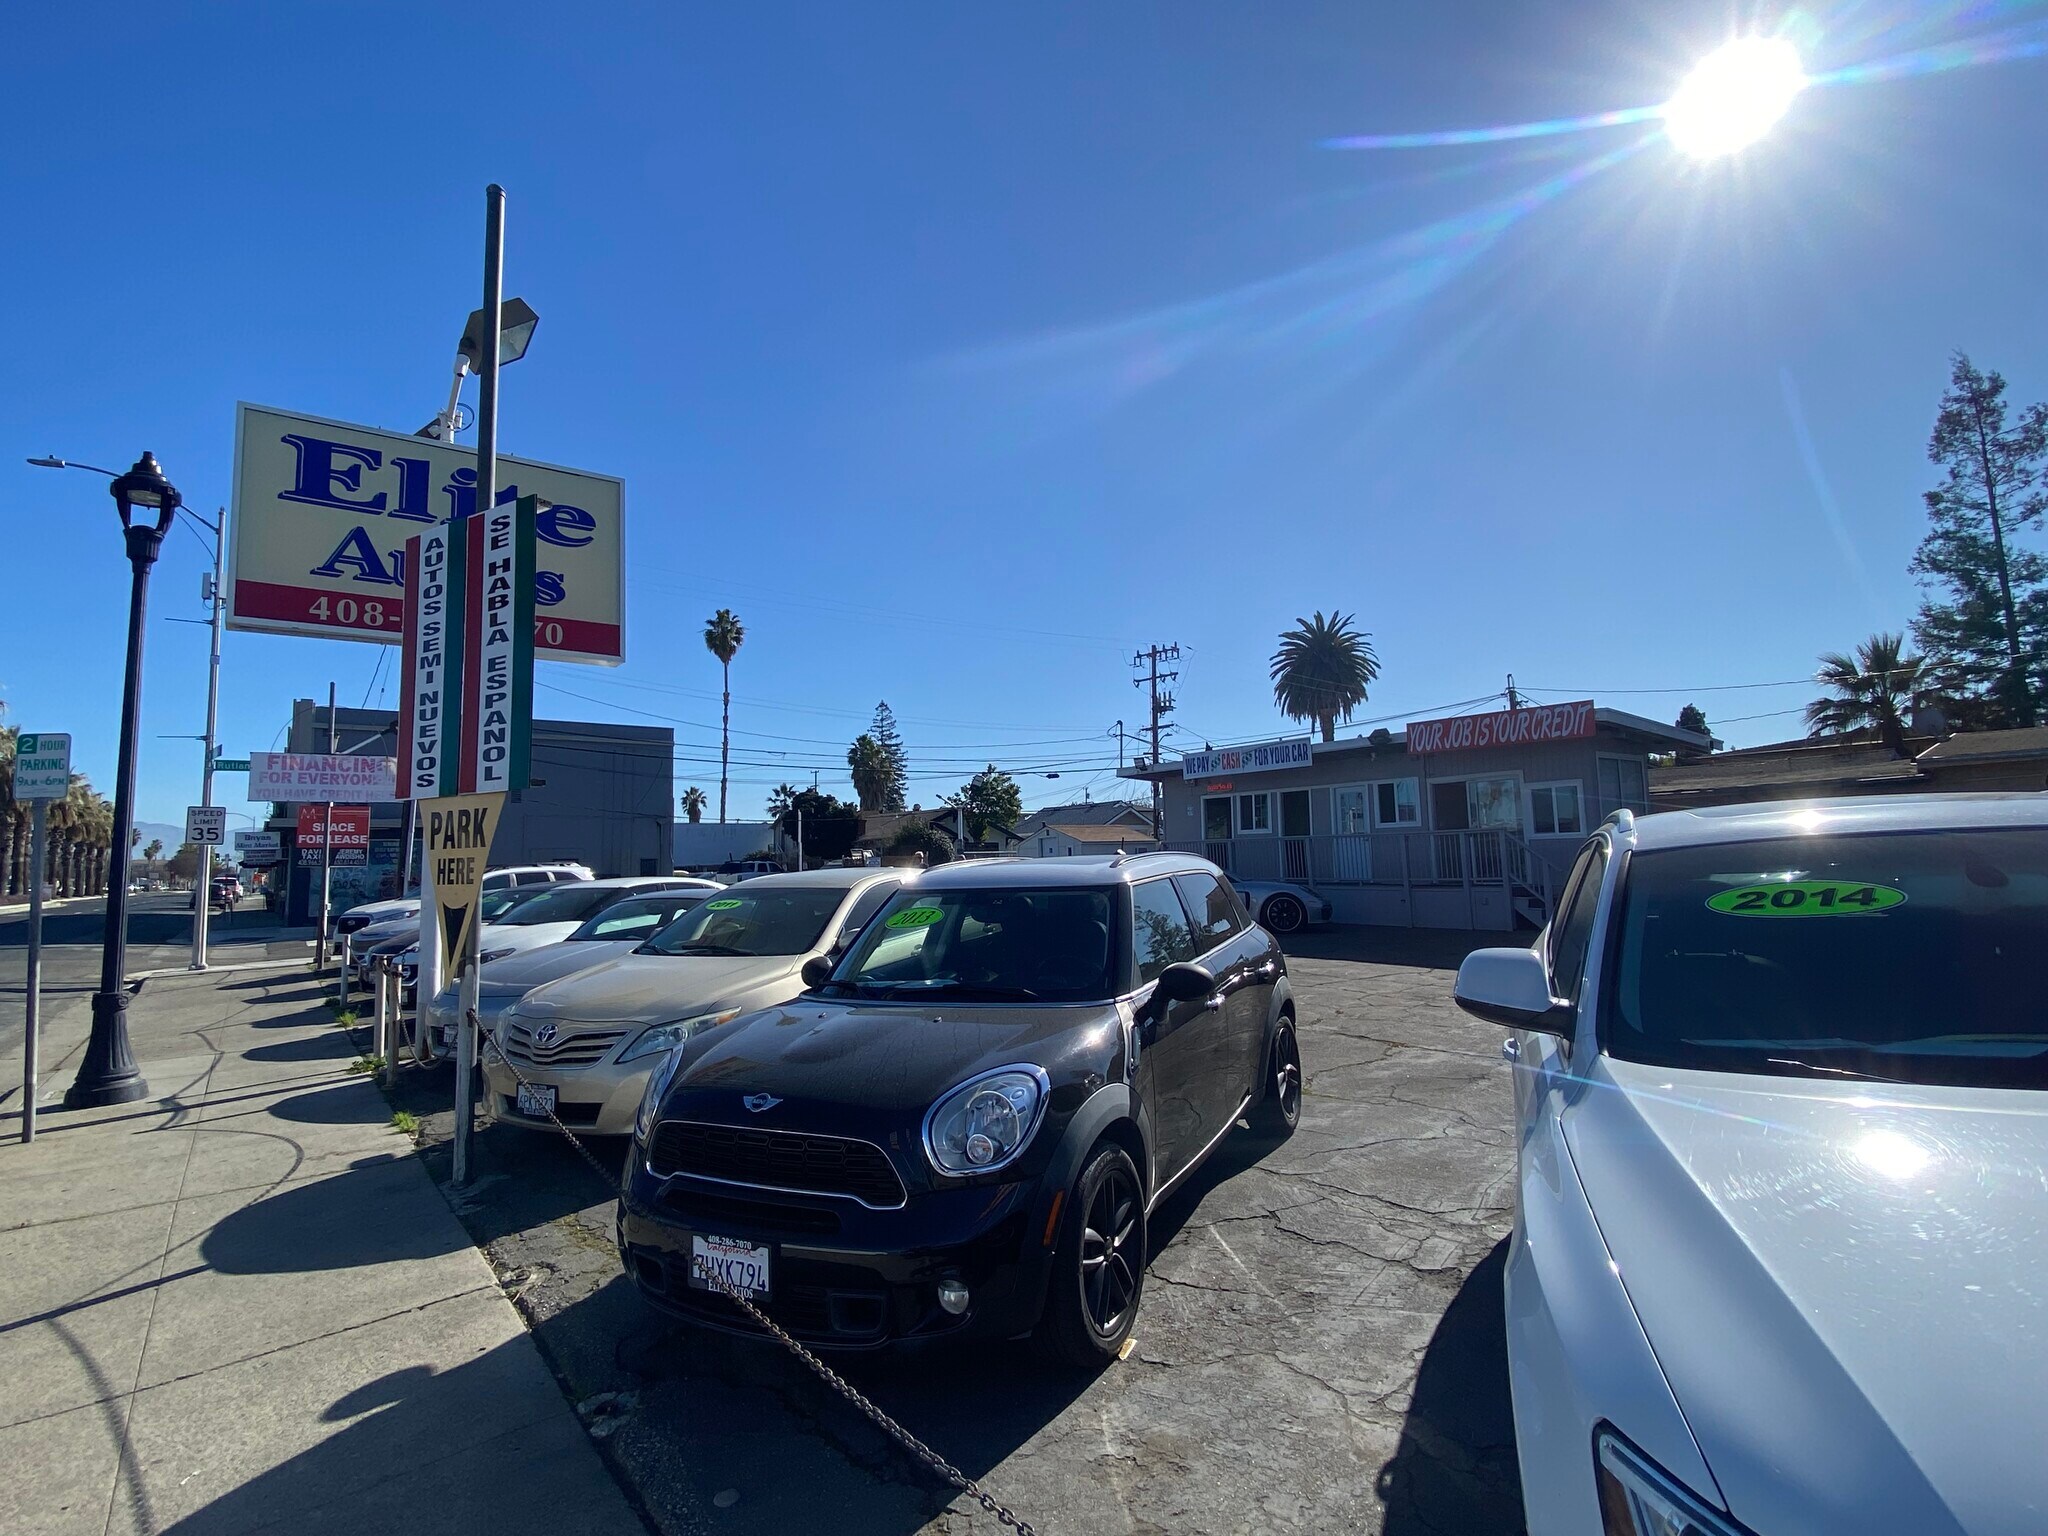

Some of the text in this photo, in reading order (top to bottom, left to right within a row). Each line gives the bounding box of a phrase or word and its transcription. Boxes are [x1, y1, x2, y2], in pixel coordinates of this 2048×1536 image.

[277, 433, 596, 547] Elie
[482, 514, 511, 782] SE HABLA ESPANOL
[416, 537, 445, 788] AUTOS SEMI NUEVOS
[1409, 704, 1592, 752] YOUR JOB IS YOUR CREDIT
[22, 737, 67, 751] 2 HOUR
[20, 758, 66, 771] PARKING
[217, 761, 250, 770] Rutlan
[1185, 757, 1198, 775] WE
[1197, 755, 1210, 773] PAY
[1221, 751, 1241, 770] CASH
[1254, 747, 1269, 766] FOR
[1269, 746, 1291, 764] YOUR
[1291, 743, 1309, 761] CAR
[259, 771, 292, 784] FOR
[284, 788, 317, 800] HAVE
[320, 789, 361, 800] CREDIT
[191, 828, 219, 841] 35
[430, 807, 489, 850] PARK
[298, 834, 369, 844] FOR LEASE
[437, 856, 476, 886] HERE
[1731, 887, 1878, 911] 2014
[892, 909, 937, 926] 2013
[707, 1235, 752, 1249] 408-286-7070
